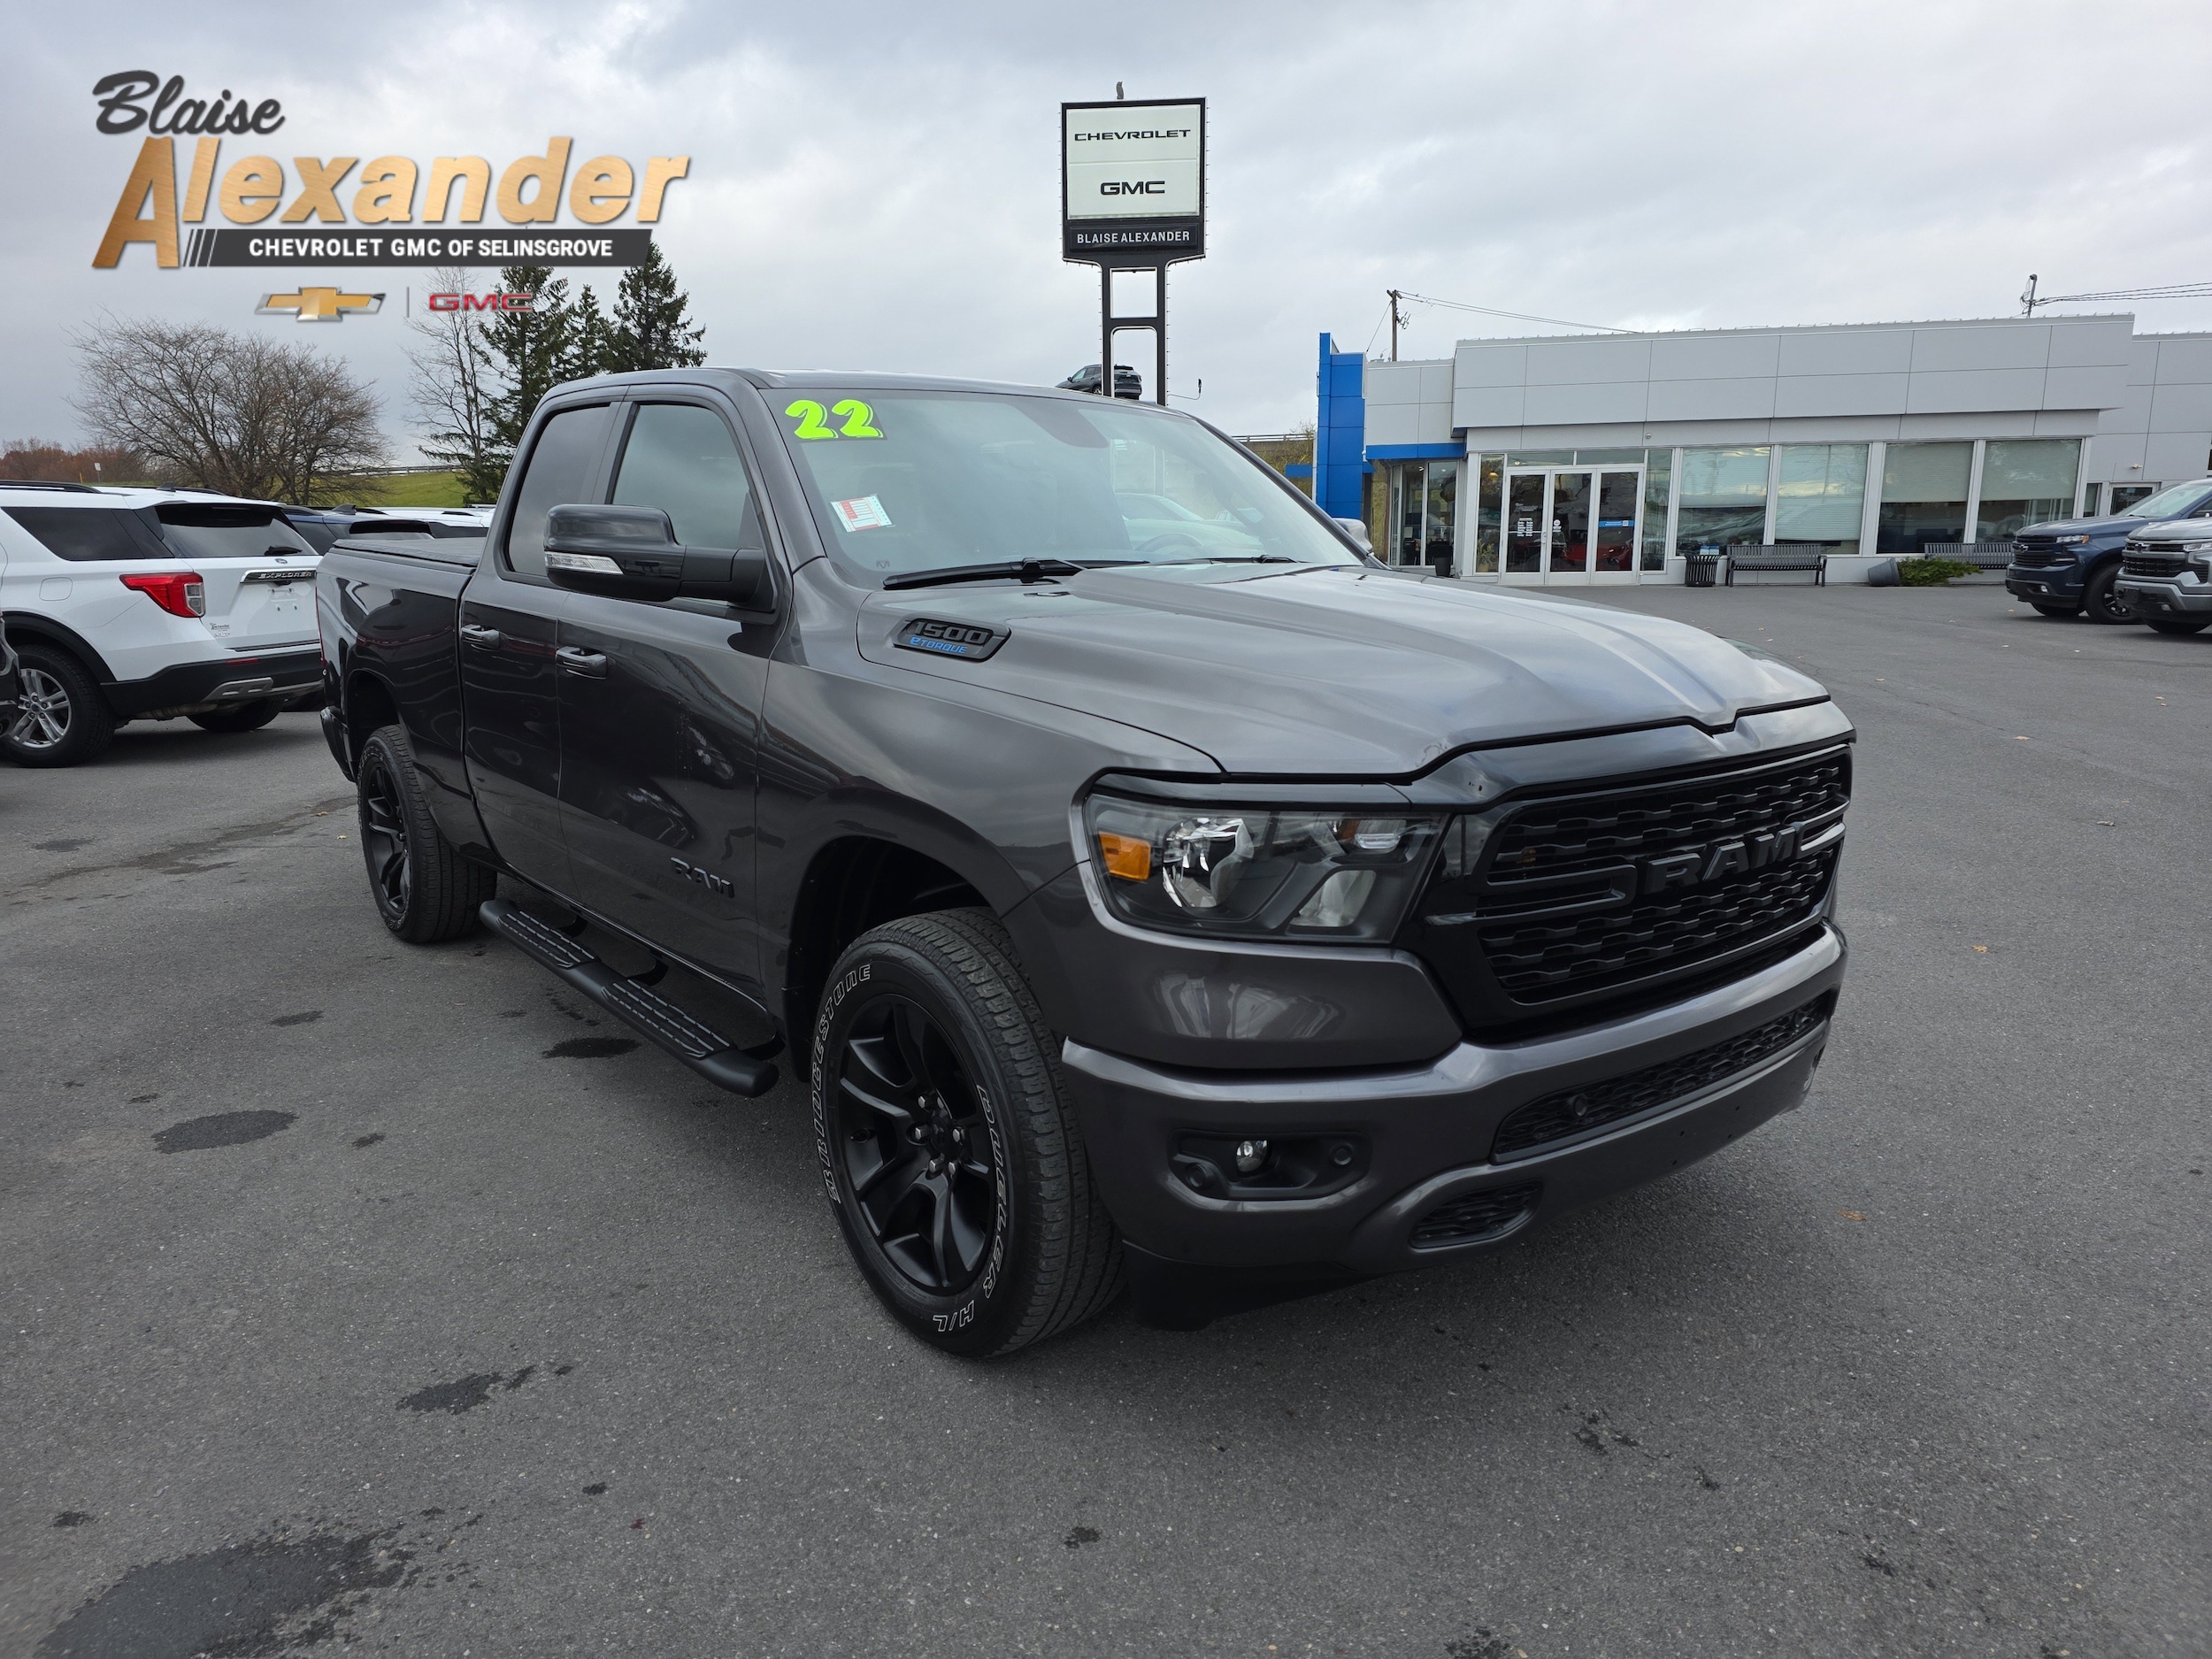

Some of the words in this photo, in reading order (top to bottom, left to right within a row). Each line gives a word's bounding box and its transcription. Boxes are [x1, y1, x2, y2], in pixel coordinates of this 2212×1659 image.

[1074, 129, 1191, 142] CHEVROLET
[1100, 180, 1165, 196] GMC
[1077, 233, 1118, 244] BLAISE
[1120, 230, 1190, 242] ALEXANDER
[785, 399, 884, 440] 22
[911, 621, 989, 645] 1500
[1642, 826, 1796, 895] RAM
[811, 964, 872, 1204] BRIDGESTONE
[976, 1084, 1008, 1299] DUELER
[932, 1300, 975, 1333] H/L
